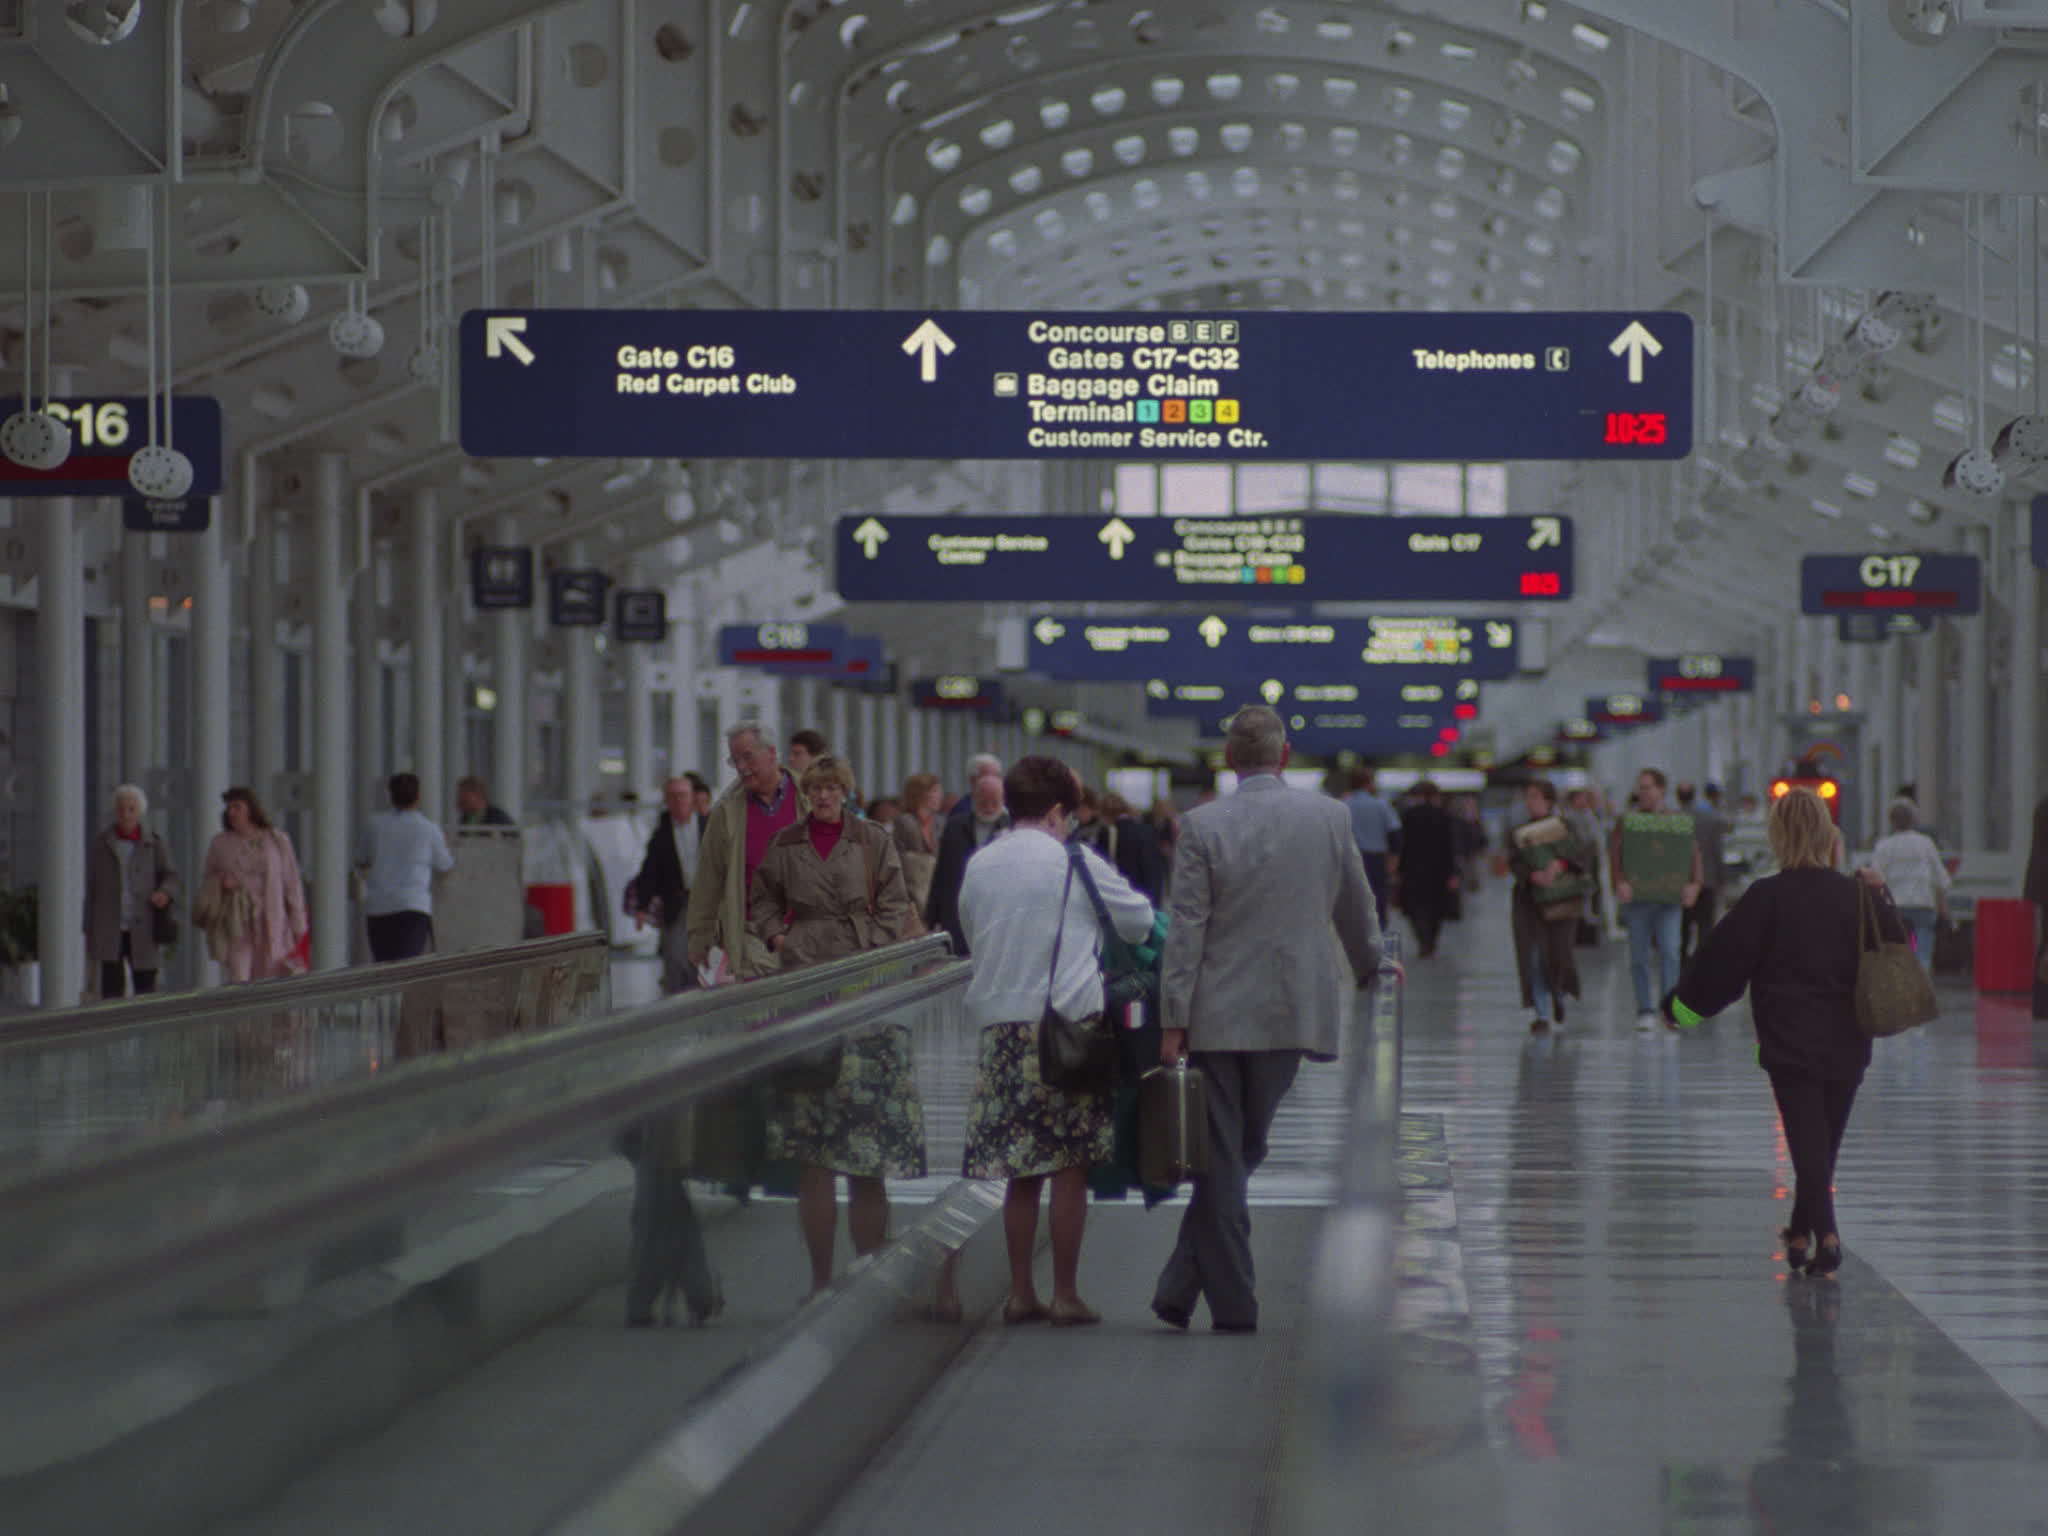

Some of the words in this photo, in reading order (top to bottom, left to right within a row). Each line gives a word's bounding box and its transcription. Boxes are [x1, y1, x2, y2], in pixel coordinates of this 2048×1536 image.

[1028, 320, 1165, 343] Concourse
[1170, 323, 1188, 342] B
[1195, 323, 1212, 342] E
[1219, 323, 1236, 342] F
[617, 346, 679, 369] Gate
[686, 346, 735, 369] C16
[1048, 347, 1124, 370] Gates
[1132, 347, 1240, 370] C17-C32
[1412, 349, 1536, 373] Telephones
[617, 373, 660, 394] Red
[665, 373, 741, 397] Carpet
[745, 373, 797, 394] Club
[1027, 374, 1140, 399] Baggage
[1147, 374, 1220, 396] Claim
[1028, 401, 1134, 423] Terminal
[1027, 427, 1133, 448] Customer
[1139, 427, 1222, 448] Service
[1227, 427, 1269, 448] Ctr.
[1604, 412, 1667, 445] 10:25
[1859, 556, 1921, 588] C17
